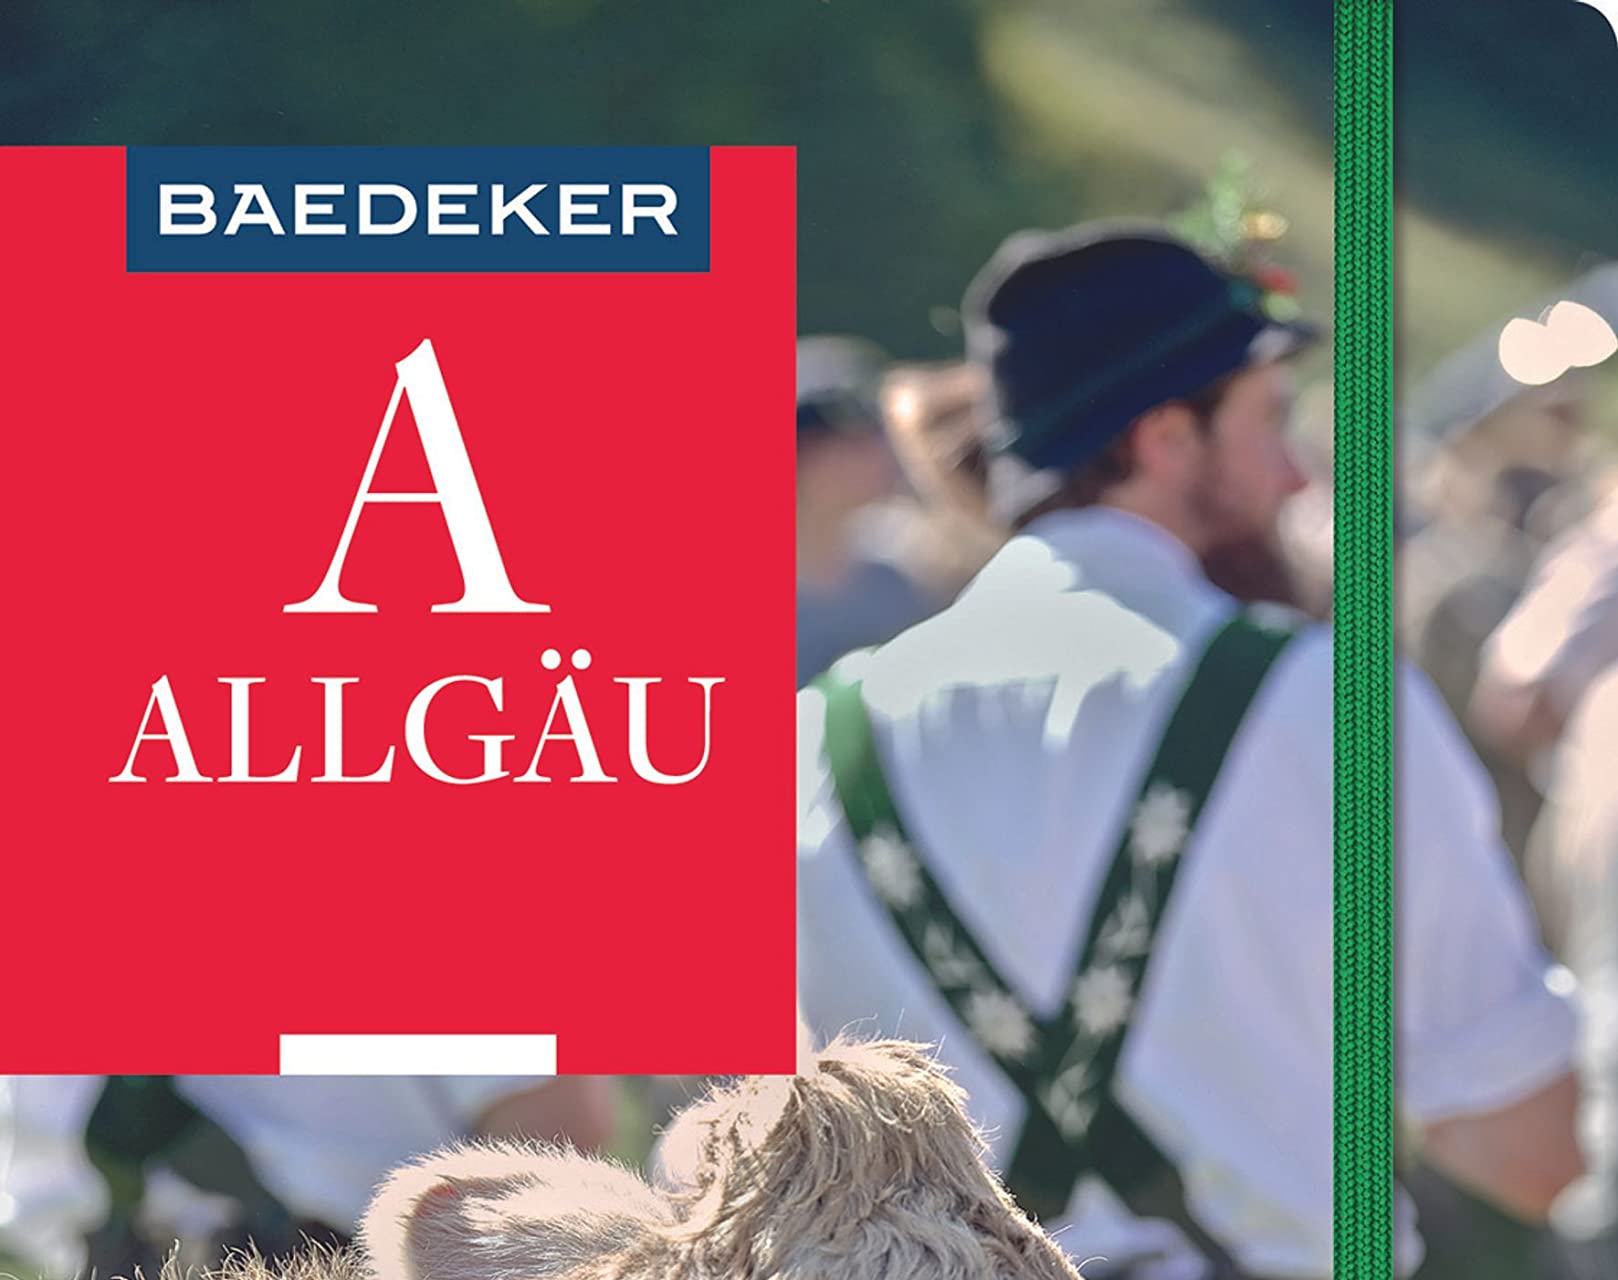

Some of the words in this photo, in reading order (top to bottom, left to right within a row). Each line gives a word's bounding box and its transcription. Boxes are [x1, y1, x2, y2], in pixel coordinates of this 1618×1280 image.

[158, 184, 678, 235] BAEDEKER
[283, 338, 551, 613] A
[109, 648, 726, 785] ALLGÄU
